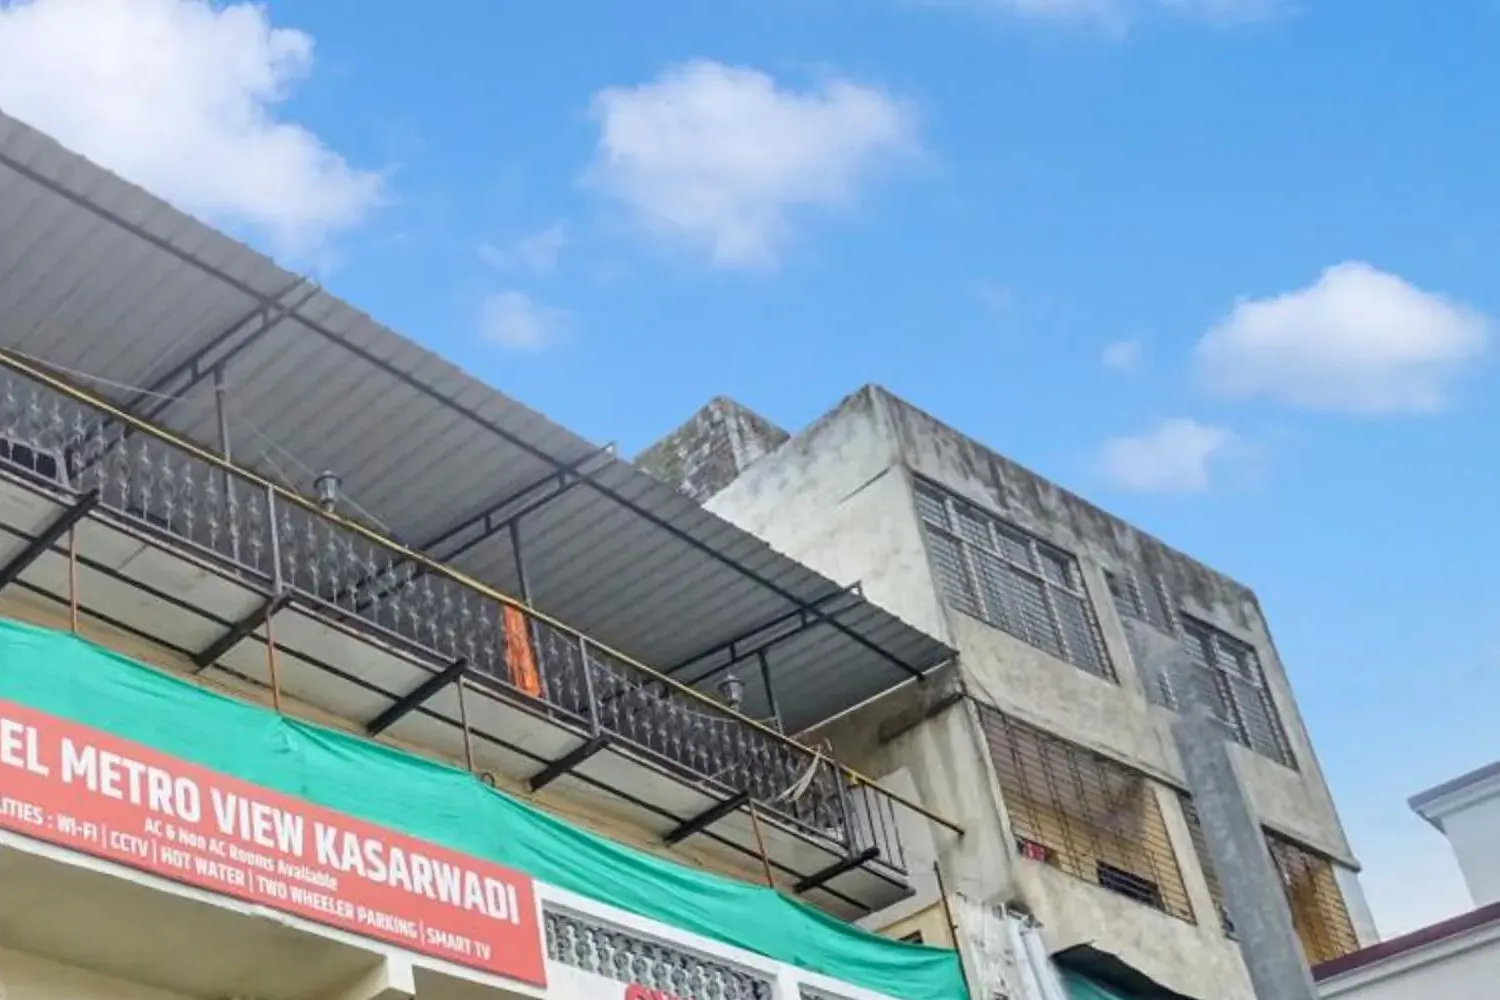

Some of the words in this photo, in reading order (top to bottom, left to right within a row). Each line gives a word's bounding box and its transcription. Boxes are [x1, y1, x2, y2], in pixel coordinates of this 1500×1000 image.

[61, 737, 201, 823] METRO
[210, 787, 304, 857] VIEW
[314, 821, 520, 925] KASARWADI
[111, 831, 149, 858] CCTV
[161, 847, 190, 871] HOT
[194, 857, 245, 887] WATER
[257, 875, 288, 899] TWO
[290, 885, 354, 920] WHEELER
[357, 905, 418, 940] PARKING
[426, 928, 471, 953] SMART
[474, 941, 491, 960] TV
[145, 818, 163, 836] AC
[178, 830, 206, 849] Non
[208, 836, 226, 856] AC
[277, 858, 338, 891] Available
